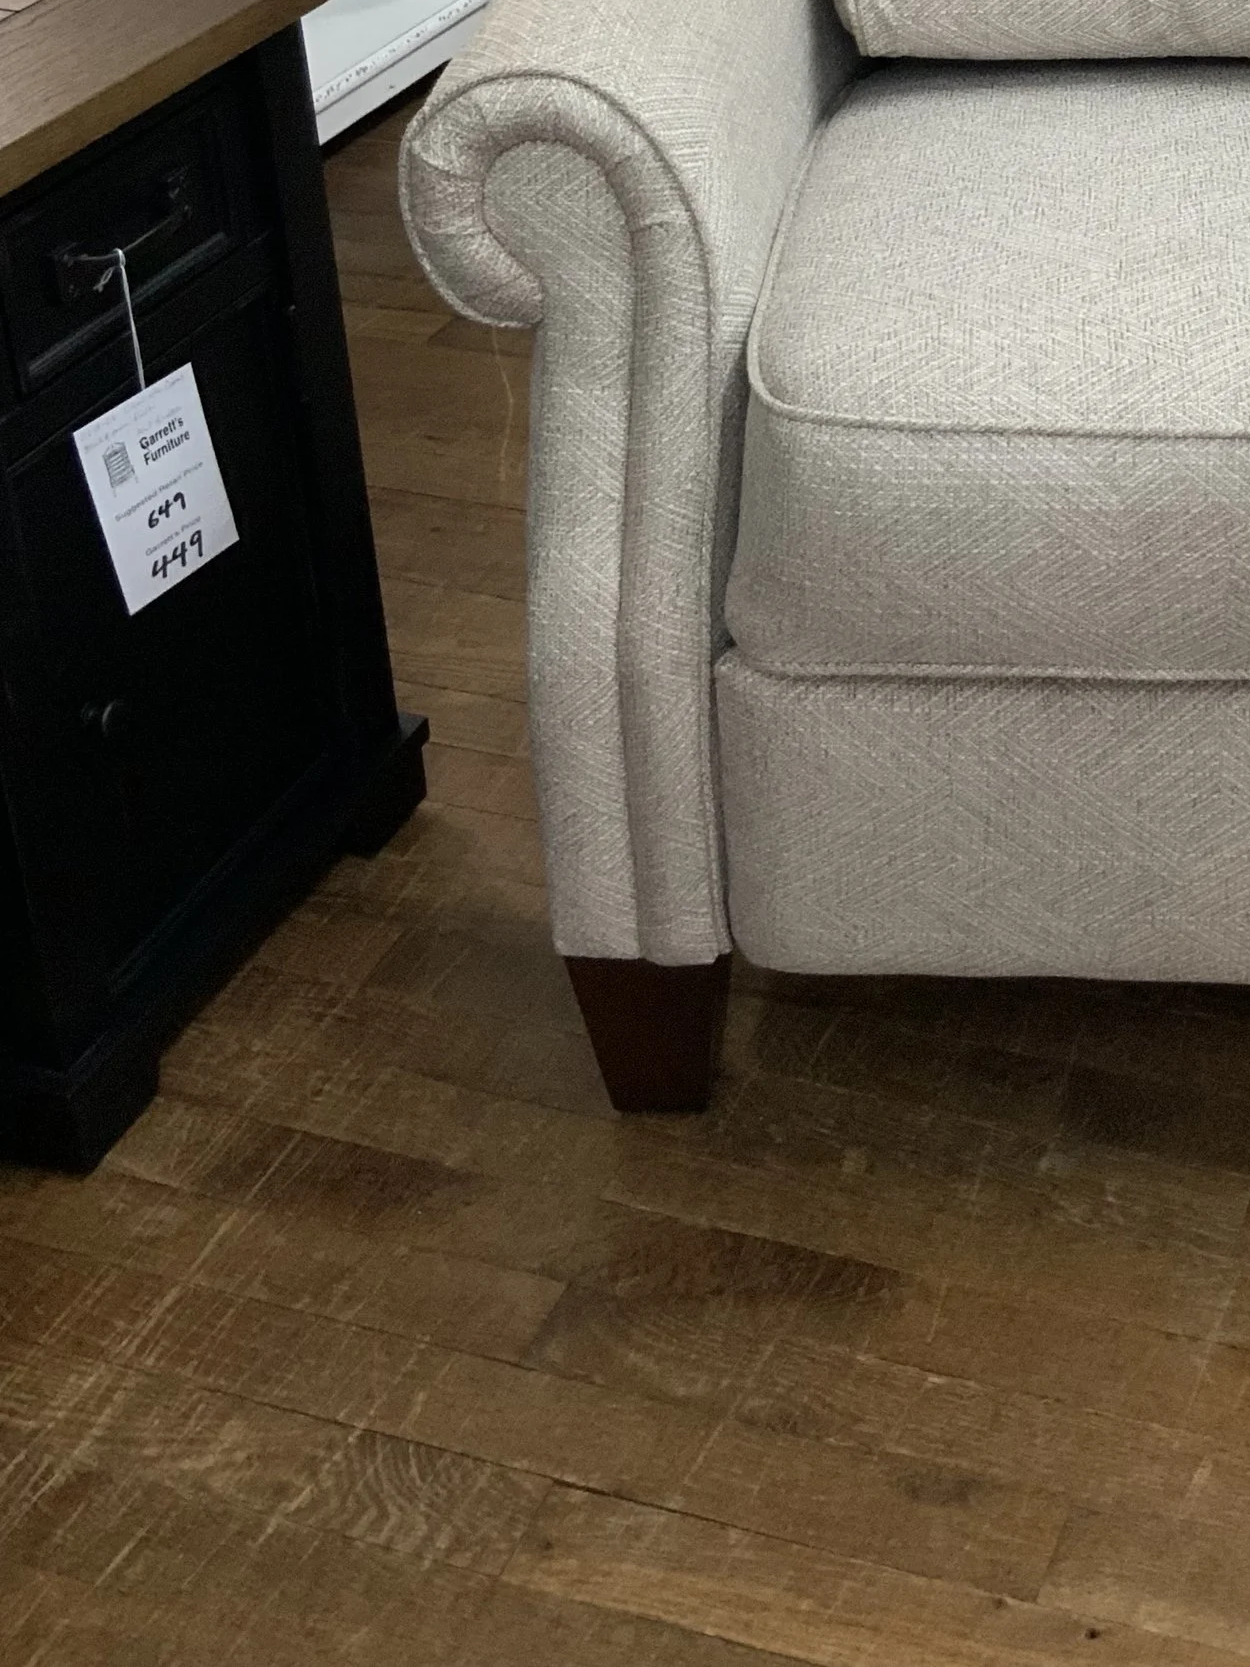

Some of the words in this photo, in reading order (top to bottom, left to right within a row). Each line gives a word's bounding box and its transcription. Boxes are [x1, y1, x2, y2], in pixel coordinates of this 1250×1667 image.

[139, 416, 184, 451] Garrett's
[143, 430, 190, 465] Furniture
[115, 489, 158, 522] Suggested
[183, 461, 204, 478] Price
[148, 492, 186, 528] 649
[152, 529, 203, 578] 449
